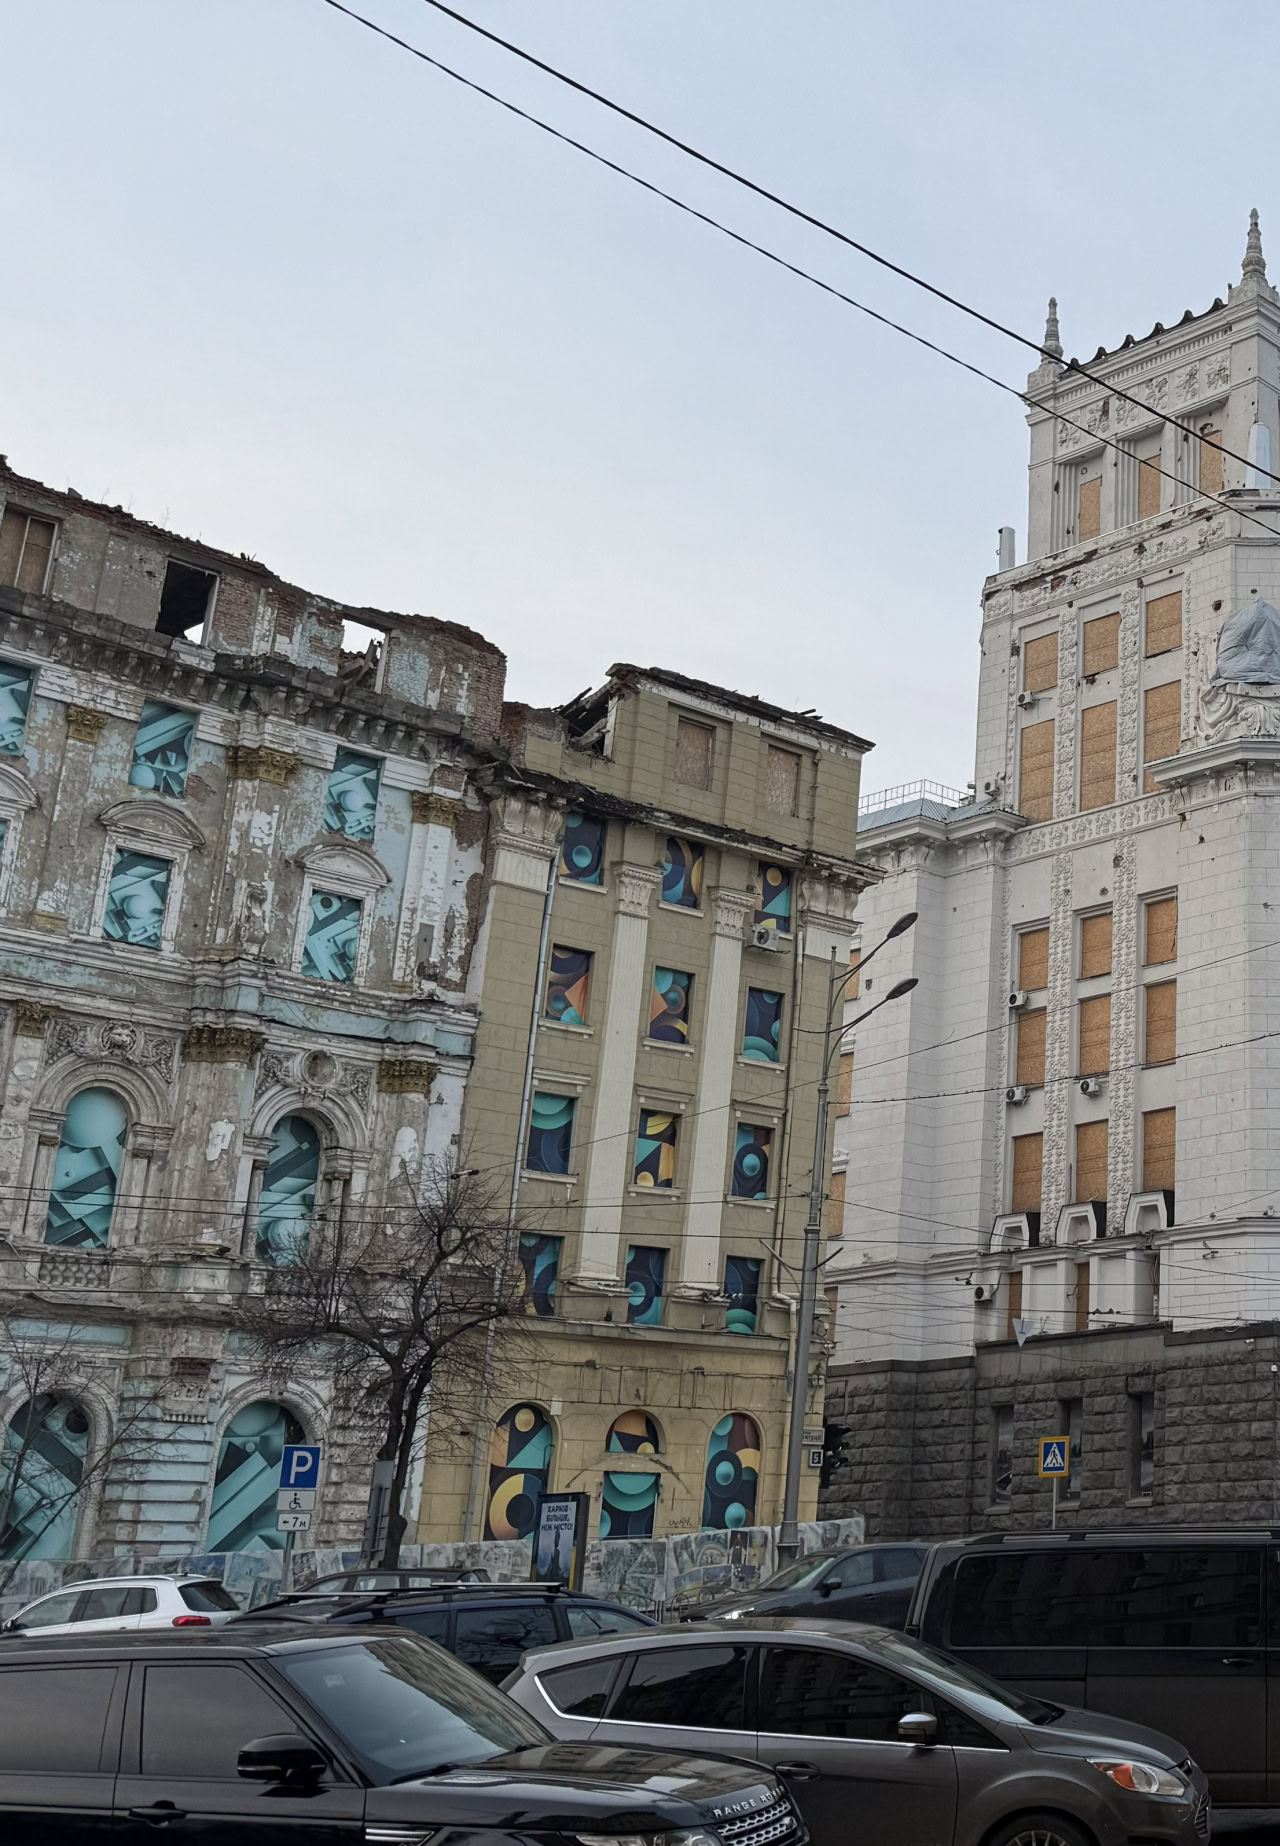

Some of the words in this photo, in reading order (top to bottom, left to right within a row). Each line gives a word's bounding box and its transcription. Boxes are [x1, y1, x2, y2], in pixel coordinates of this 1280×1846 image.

[813, 1453, 819, 1463] 5
[289, 1450, 313, 1484] P
[547, 1505, 568, 1513] ХАРКІВ
[292, 1516, 299, 1528] 7
[713, 1799, 756, 1818] RANGE
[760, 1785, 785, 1804] ROVER
